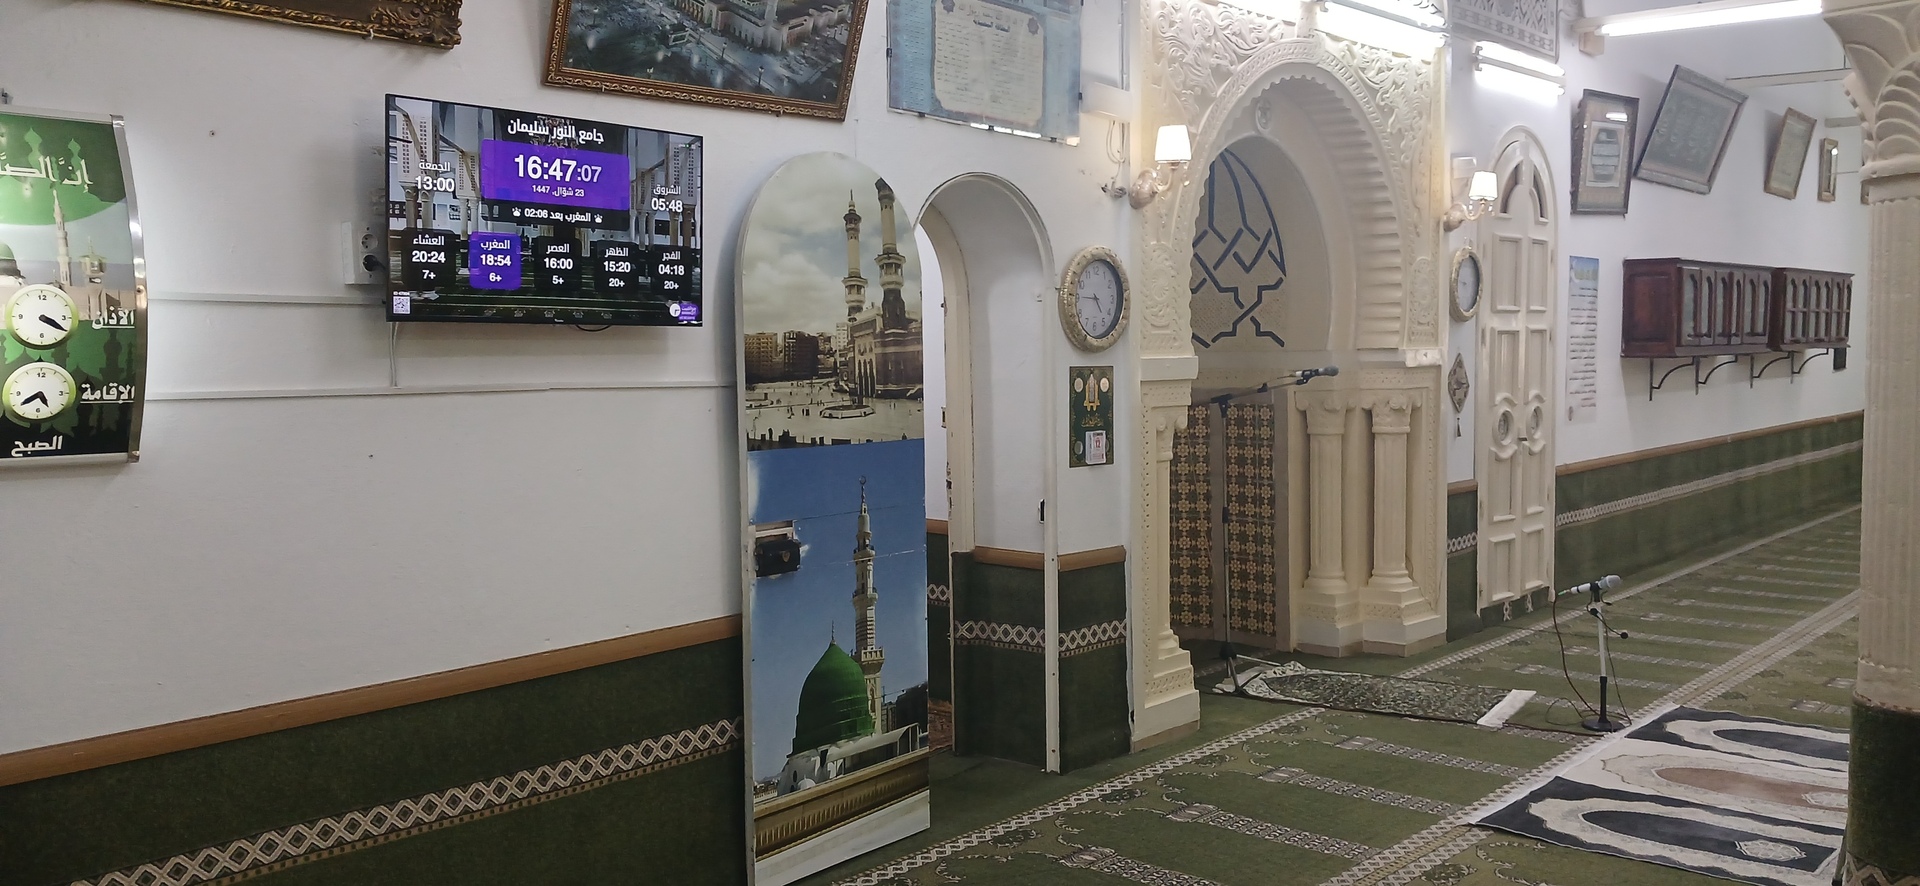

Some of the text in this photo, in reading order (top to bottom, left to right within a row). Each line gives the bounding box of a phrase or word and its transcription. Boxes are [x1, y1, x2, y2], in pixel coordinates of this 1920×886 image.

[508, 118, 605, 145] جامع النور سليمان
[418, 159, 451, 172] الجمعة
[514, 154, 602, 183] 16:47:07
[415, 176, 455, 191] 13:00
[531, 184, 550, 194] 1447
[653, 184, 681, 196] الشروق
[574, 188, 585, 197] 23
[651, 198, 683, 213] 05:48
[524, 208, 591, 223] المغرب بعد 02:06
[412, 233, 445, 246] العشاء
[480, 239, 511, 251] المغرب
[546, 243, 570, 254] العصر
[604, 247, 629, 257] الظهر
[411, 250, 446, 264] 20:24
[480, 254, 511, 267] 18:54
[661, 250, 681, 261] الفجر
[543, 257, 573, 270] 16:00
[603, 260, 631, 273] 15:20
[658, 263, 685, 276] 04:18
[11, 435, 64, 457] الصبح
